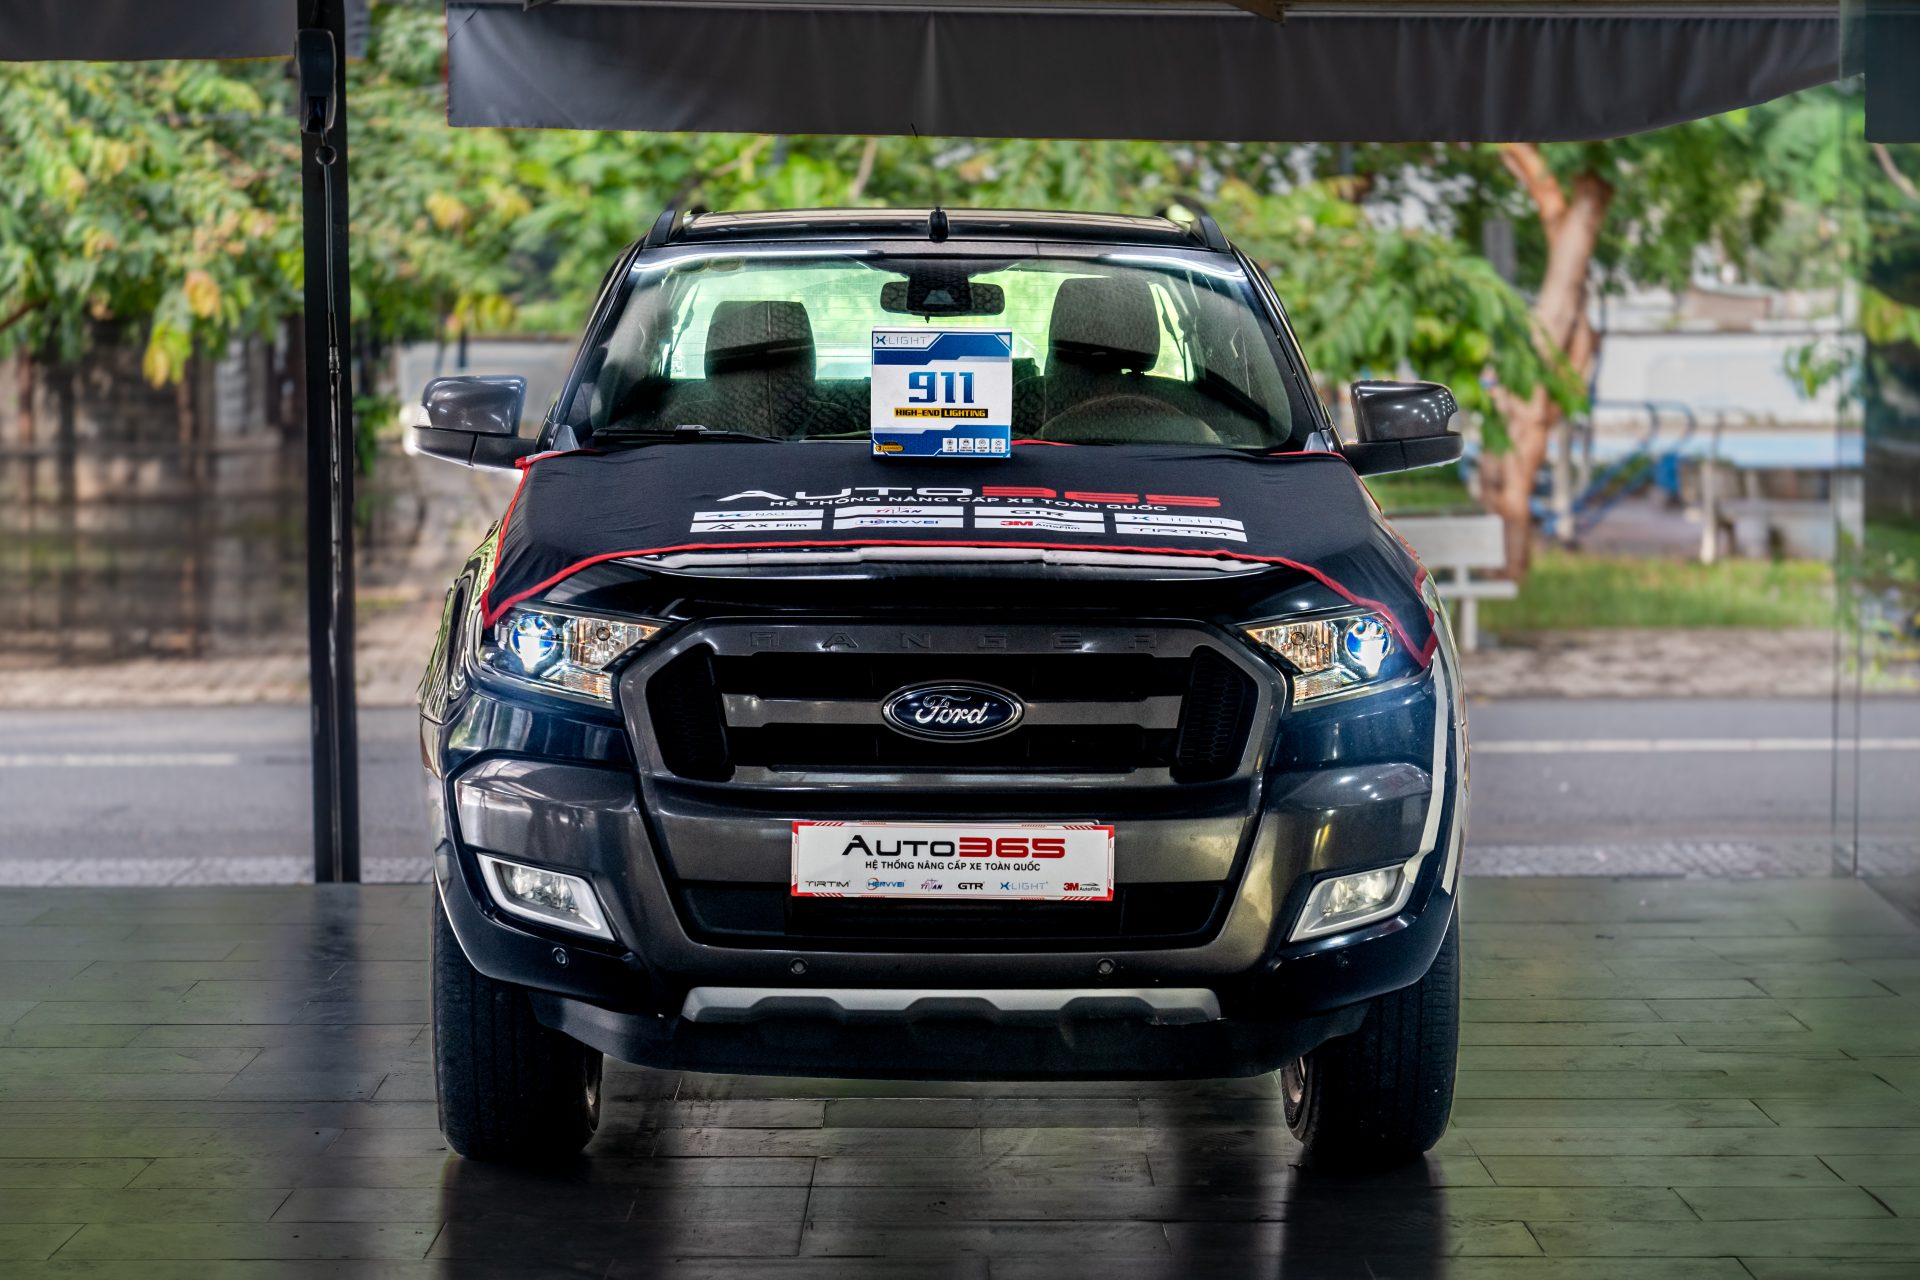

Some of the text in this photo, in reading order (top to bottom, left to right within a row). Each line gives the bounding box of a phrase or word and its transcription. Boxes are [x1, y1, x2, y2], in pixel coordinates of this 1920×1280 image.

[908, 371, 974, 404] 911
[895, 409, 986, 418] HIGH-END LIGHTING
[1041, 498, 1099, 509] TOÀN
[1010, 508, 1065, 517] GTR
[750, 631, 1159, 650] RANGER
[915, 694, 989, 725] Ford
[865, 858, 1041, 872] HỆ THỐNG NÂNG CẤP XE TOÀN QUỐC
[958, 882, 984, 890] GTR
[1063, 882, 1079, 892] 3M
